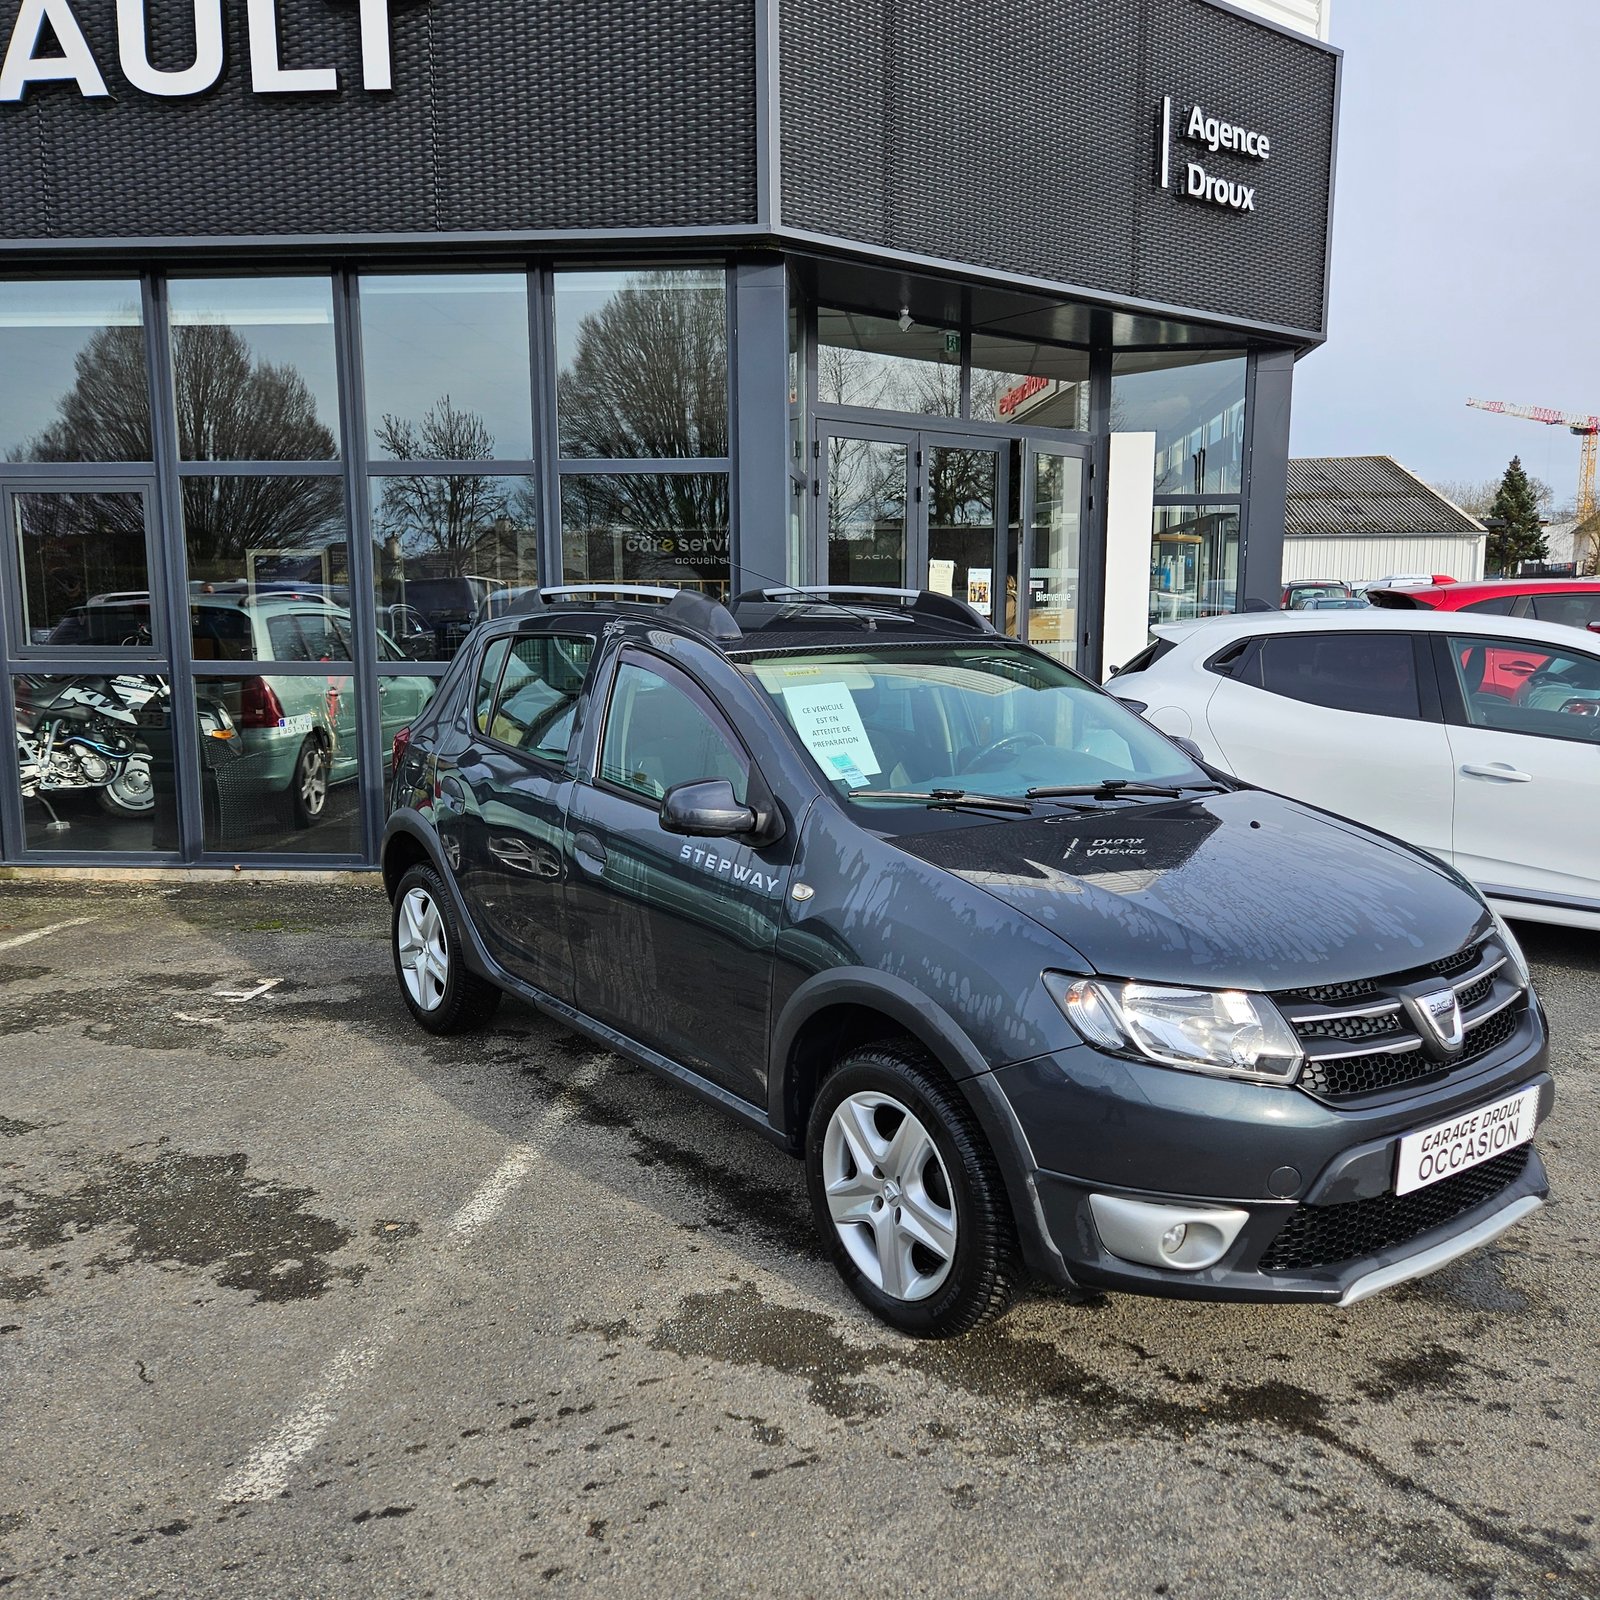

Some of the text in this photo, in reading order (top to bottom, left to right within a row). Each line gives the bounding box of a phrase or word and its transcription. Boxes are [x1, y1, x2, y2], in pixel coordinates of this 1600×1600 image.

[1187, 106, 1270, 159] Agence
[1187, 163, 1255, 211] Droux
[626, 537, 675, 552] care
[675, 555, 716, 565] accueil
[1035, 591, 1072, 602] Bienvenue
[812, 703, 845, 714] VEHICULE
[816, 716, 828, 725] EST
[812, 725, 852, 737] ATTENTE DE
[680, 844, 780, 892] STEPWAY
[1429, 997, 1455, 1014] DACIA
[1421, 1097, 1525, 1153] GARAGE DROUX
[1418, 1118, 1520, 1181] OCCASION
